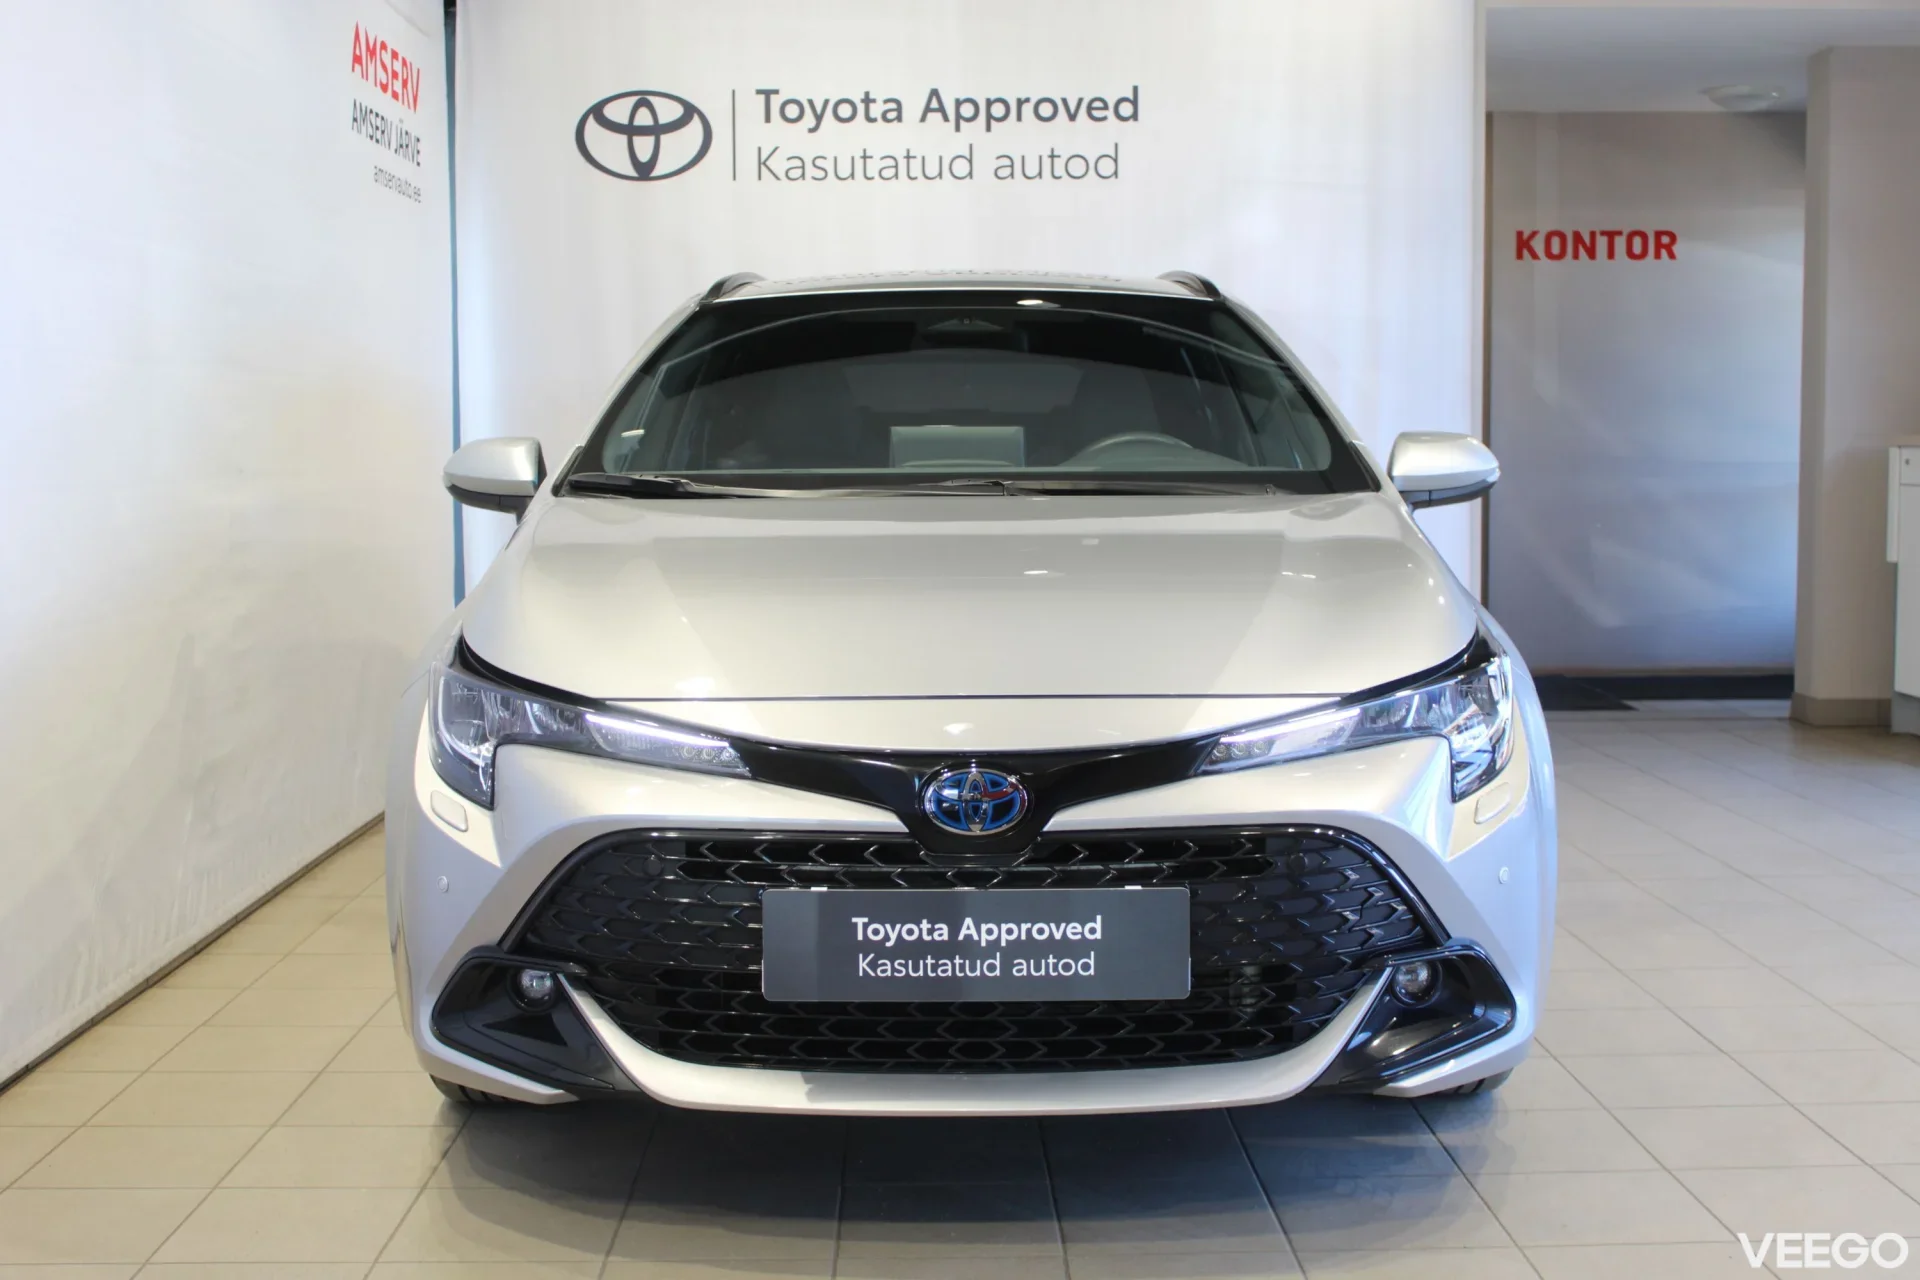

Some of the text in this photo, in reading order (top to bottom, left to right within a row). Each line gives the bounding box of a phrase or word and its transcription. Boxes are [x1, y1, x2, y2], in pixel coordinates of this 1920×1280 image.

[352, 20, 420, 114] AMSERV
[756, 86, 1139, 133] Toyota Approved
[352, 98, 421, 167] AMSERV JÄRVE
[757, 143, 1119, 181] Kasutatud autod
[1515, 230, 1677, 261] KONTOR
[852, 915, 1102, 947] Toyota Approved
[858, 951, 1095, 977] Kasutatud autod
